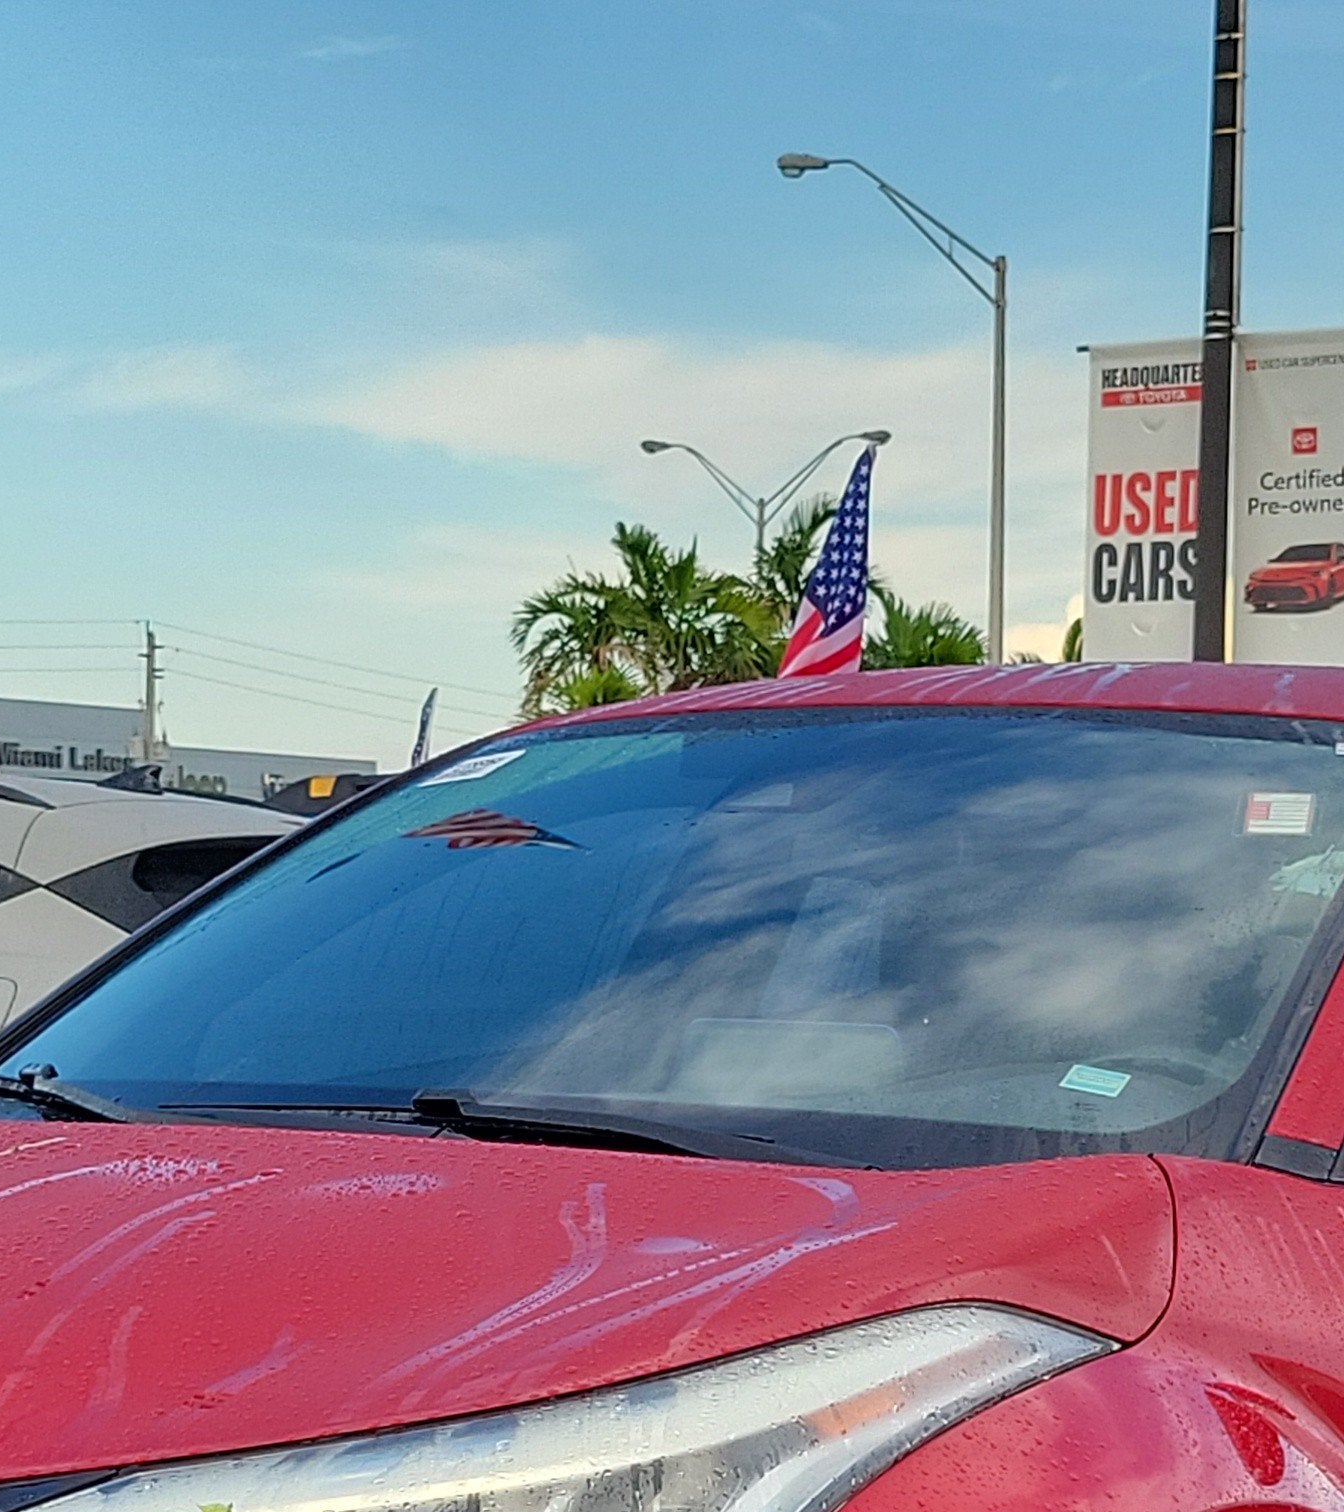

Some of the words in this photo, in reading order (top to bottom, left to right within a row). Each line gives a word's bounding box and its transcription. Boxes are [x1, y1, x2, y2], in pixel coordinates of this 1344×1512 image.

[1102, 362, 1202, 388] HEADQUARTE
[1139, 388, 1187, 405] TOYOTA
[1094, 469, 1200, 537] USED
[1092, 538, 1197, 603] CARS
